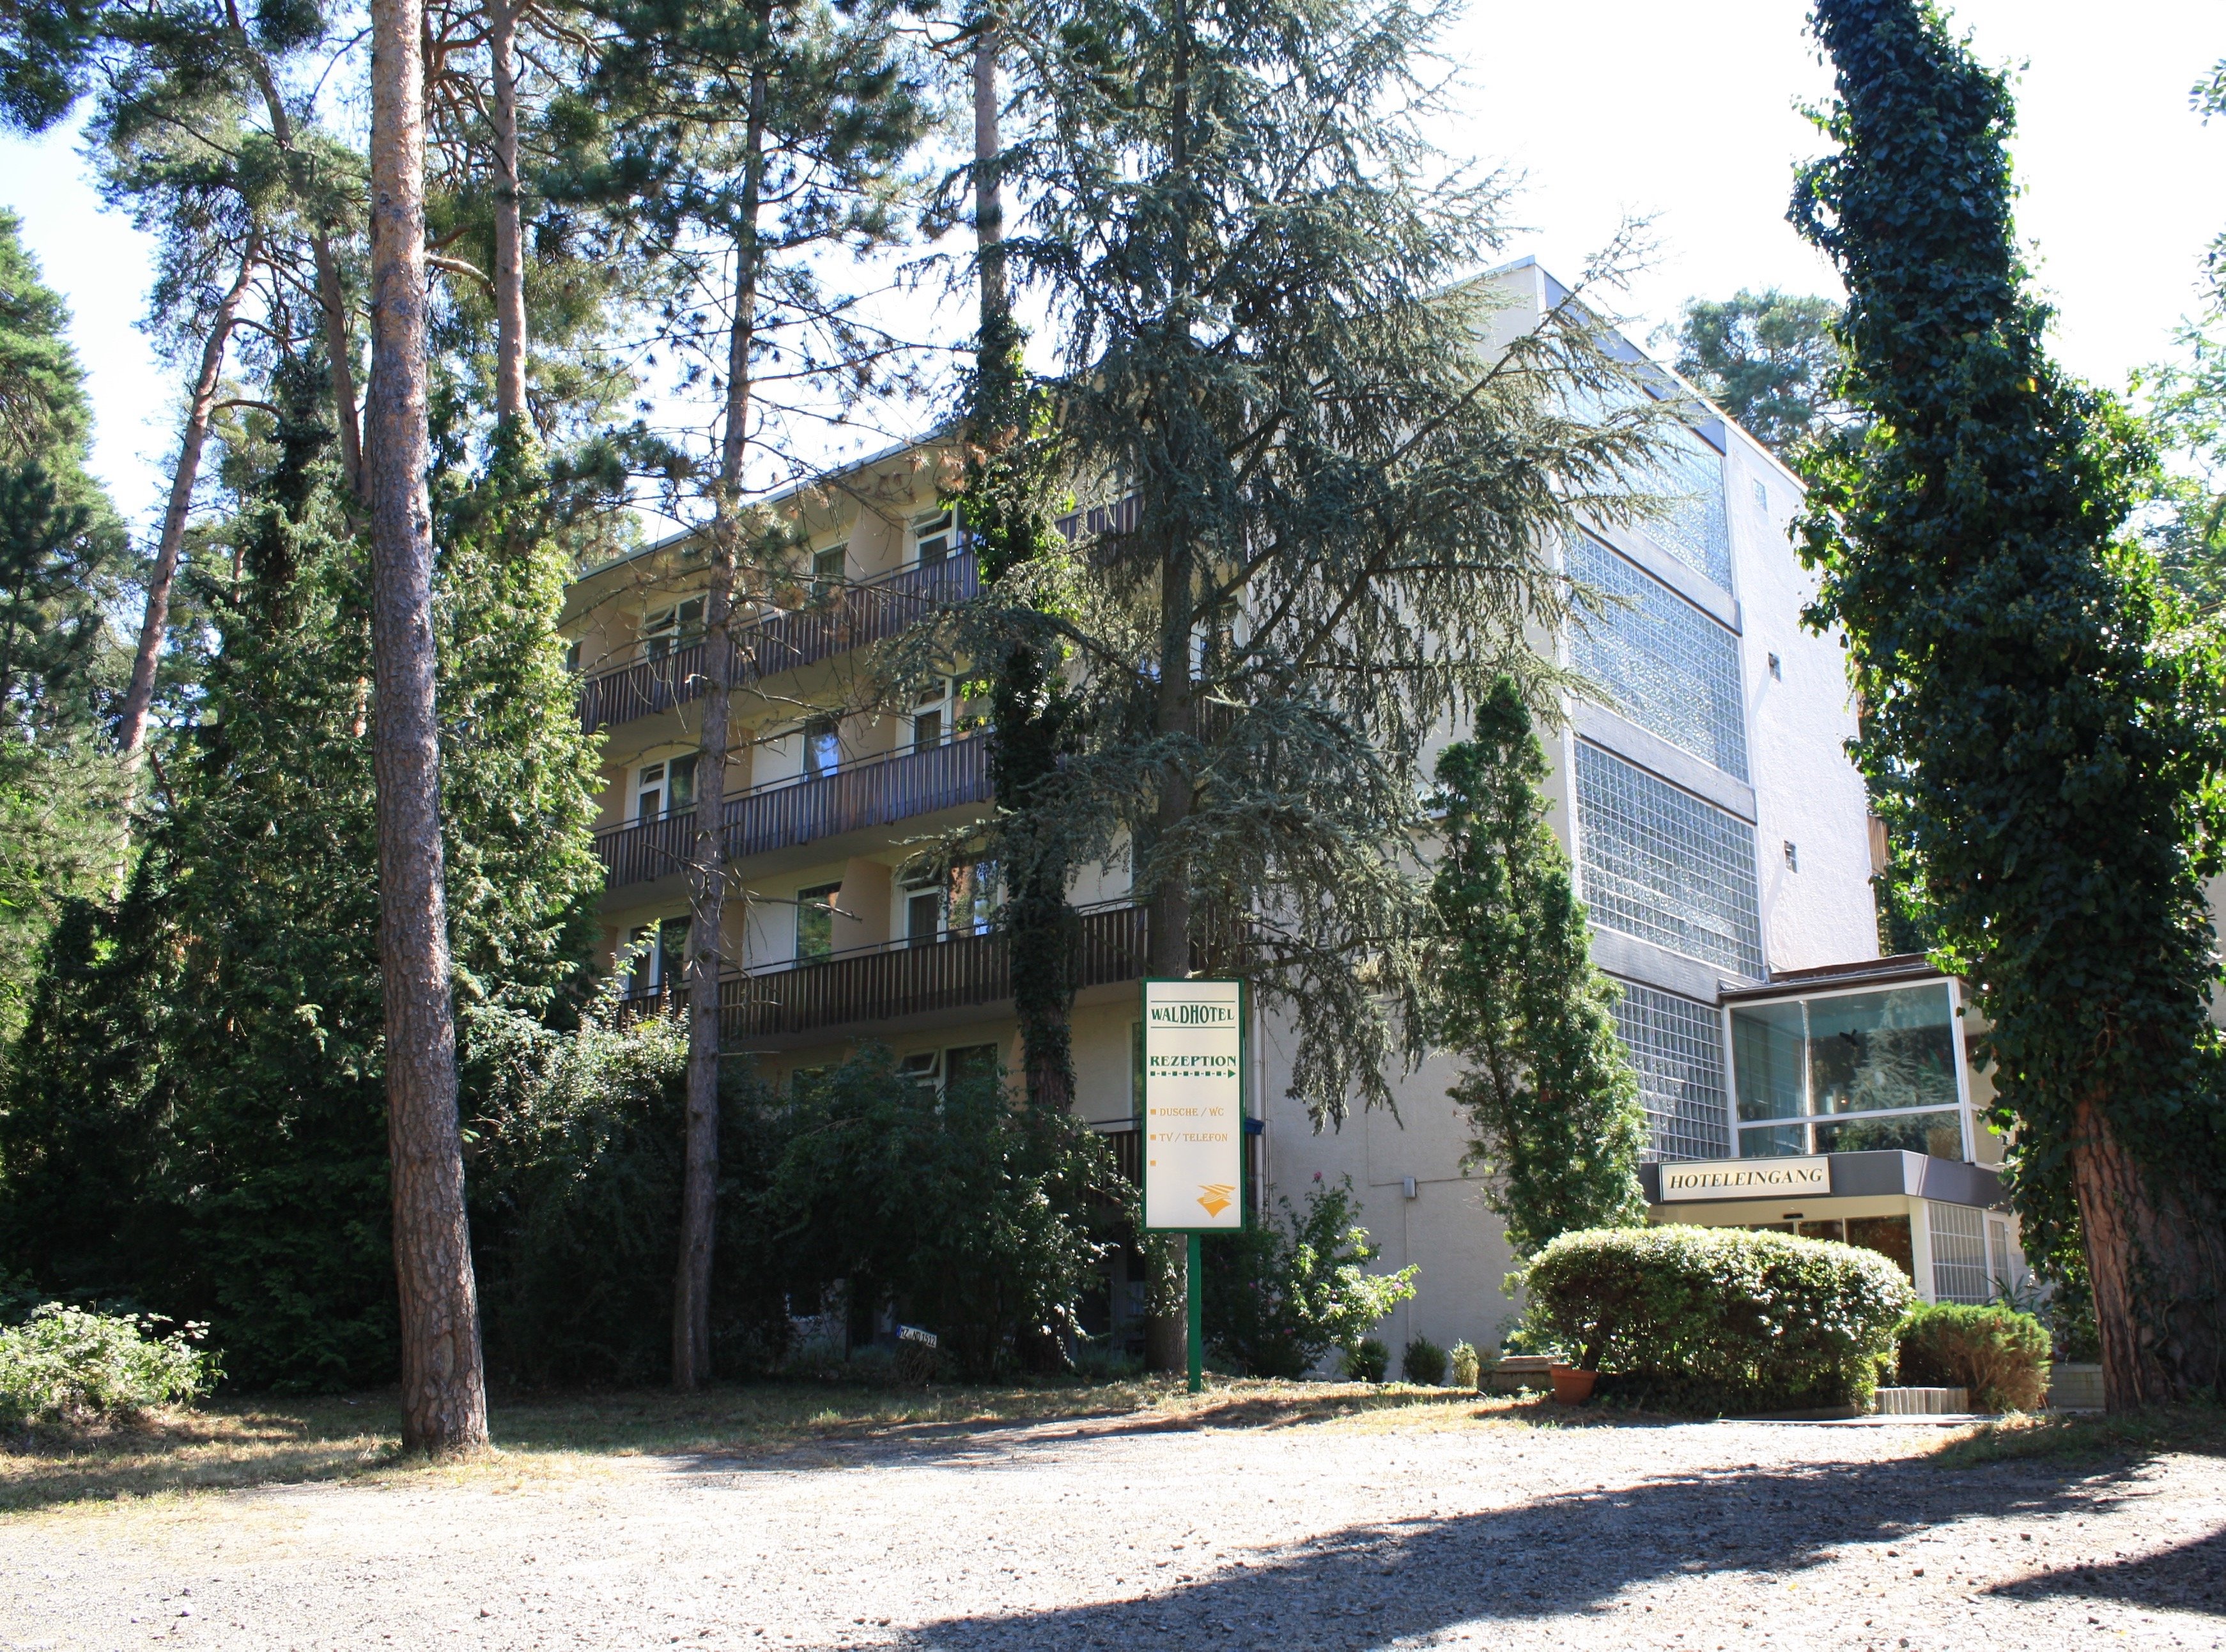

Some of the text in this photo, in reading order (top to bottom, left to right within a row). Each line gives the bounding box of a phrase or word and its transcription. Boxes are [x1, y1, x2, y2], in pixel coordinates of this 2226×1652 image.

[1151, 1005, 1235, 1024] WALDHOTEL
[1150, 1056, 1236, 1067] REZEPTION
[1670, 1168, 1823, 1189] HOTELEINGANG
